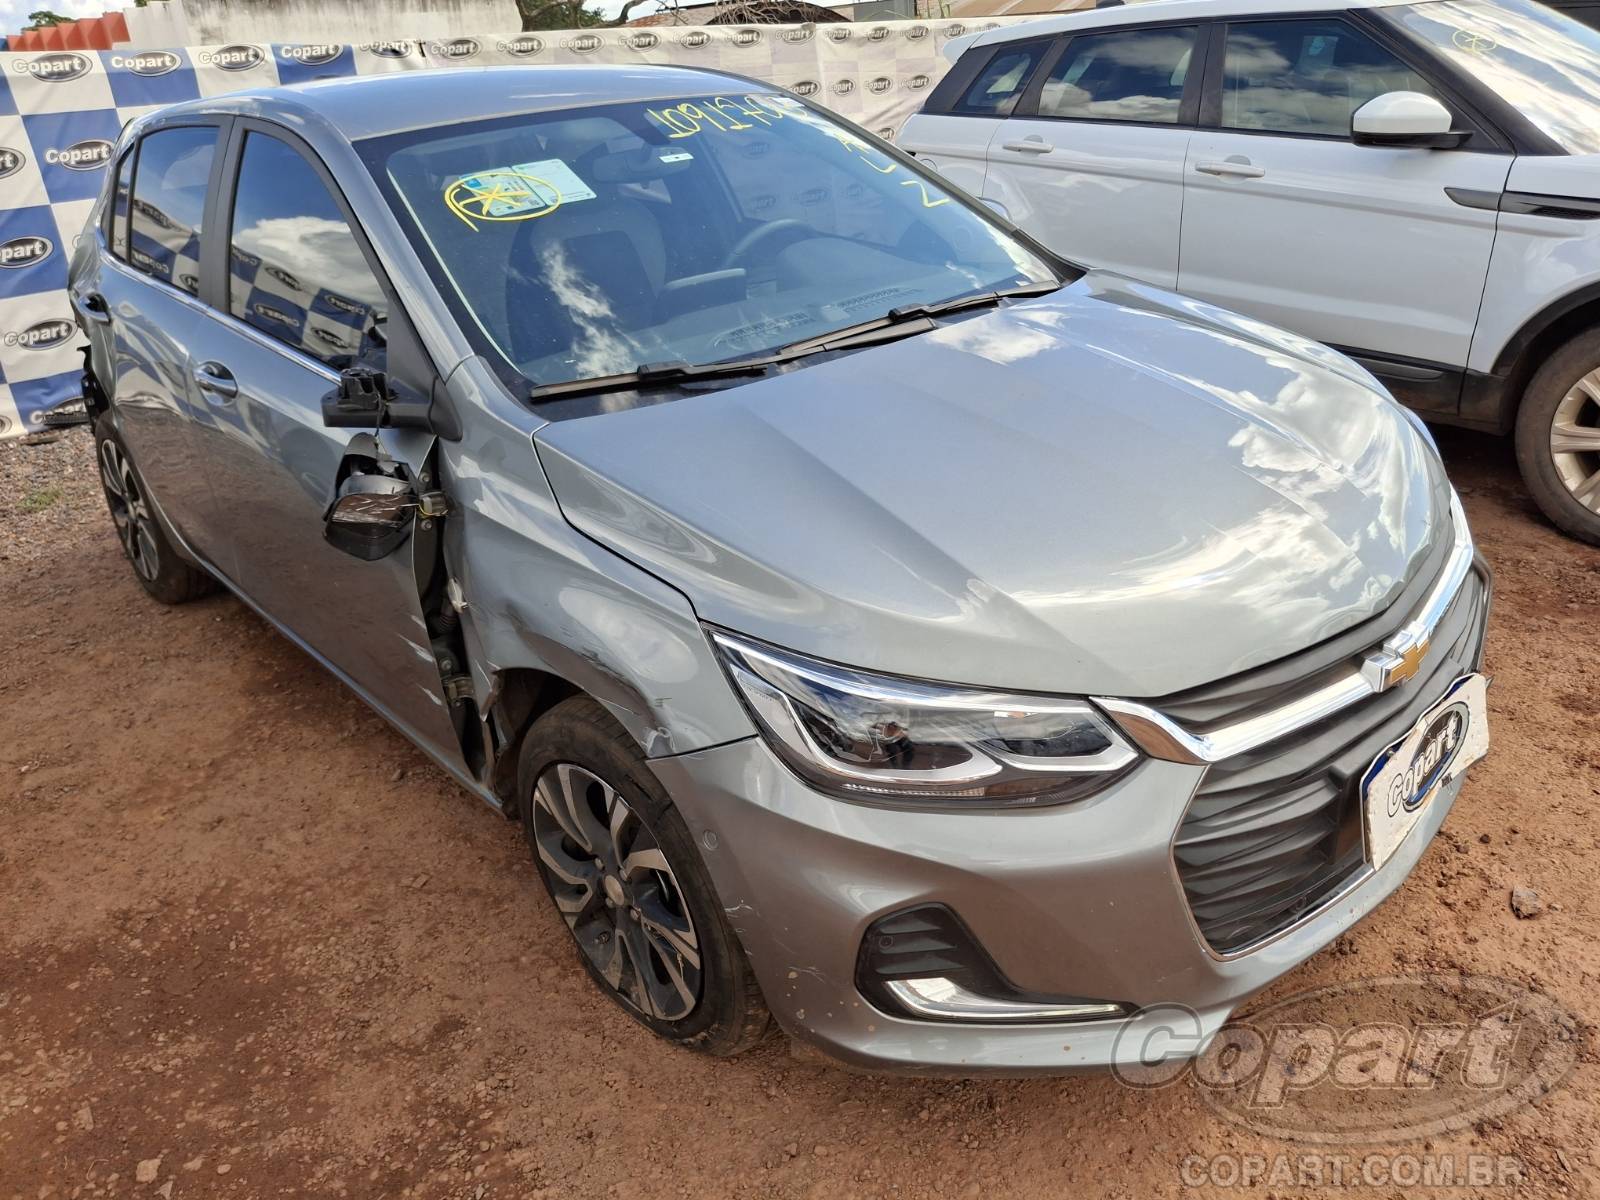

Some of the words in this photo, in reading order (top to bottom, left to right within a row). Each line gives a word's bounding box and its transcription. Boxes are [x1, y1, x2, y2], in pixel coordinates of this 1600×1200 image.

[431, 42, 476, 56] Copart
[497, 39, 539, 53] Copart
[559, 37, 599, 52] Copart
[618, 35, 656, 49] Copart
[199, 50, 254, 66] Copart
[280, 45, 334, 61] Copart
[11, 57, 82, 77] Copart
[111, 54, 173, 71] Copart
[45, 145, 109, 165] Copart
[0, 241, 43, 263] part
[5, 322, 69, 347] Copart
[1387, 710, 1460, 818] Copart
